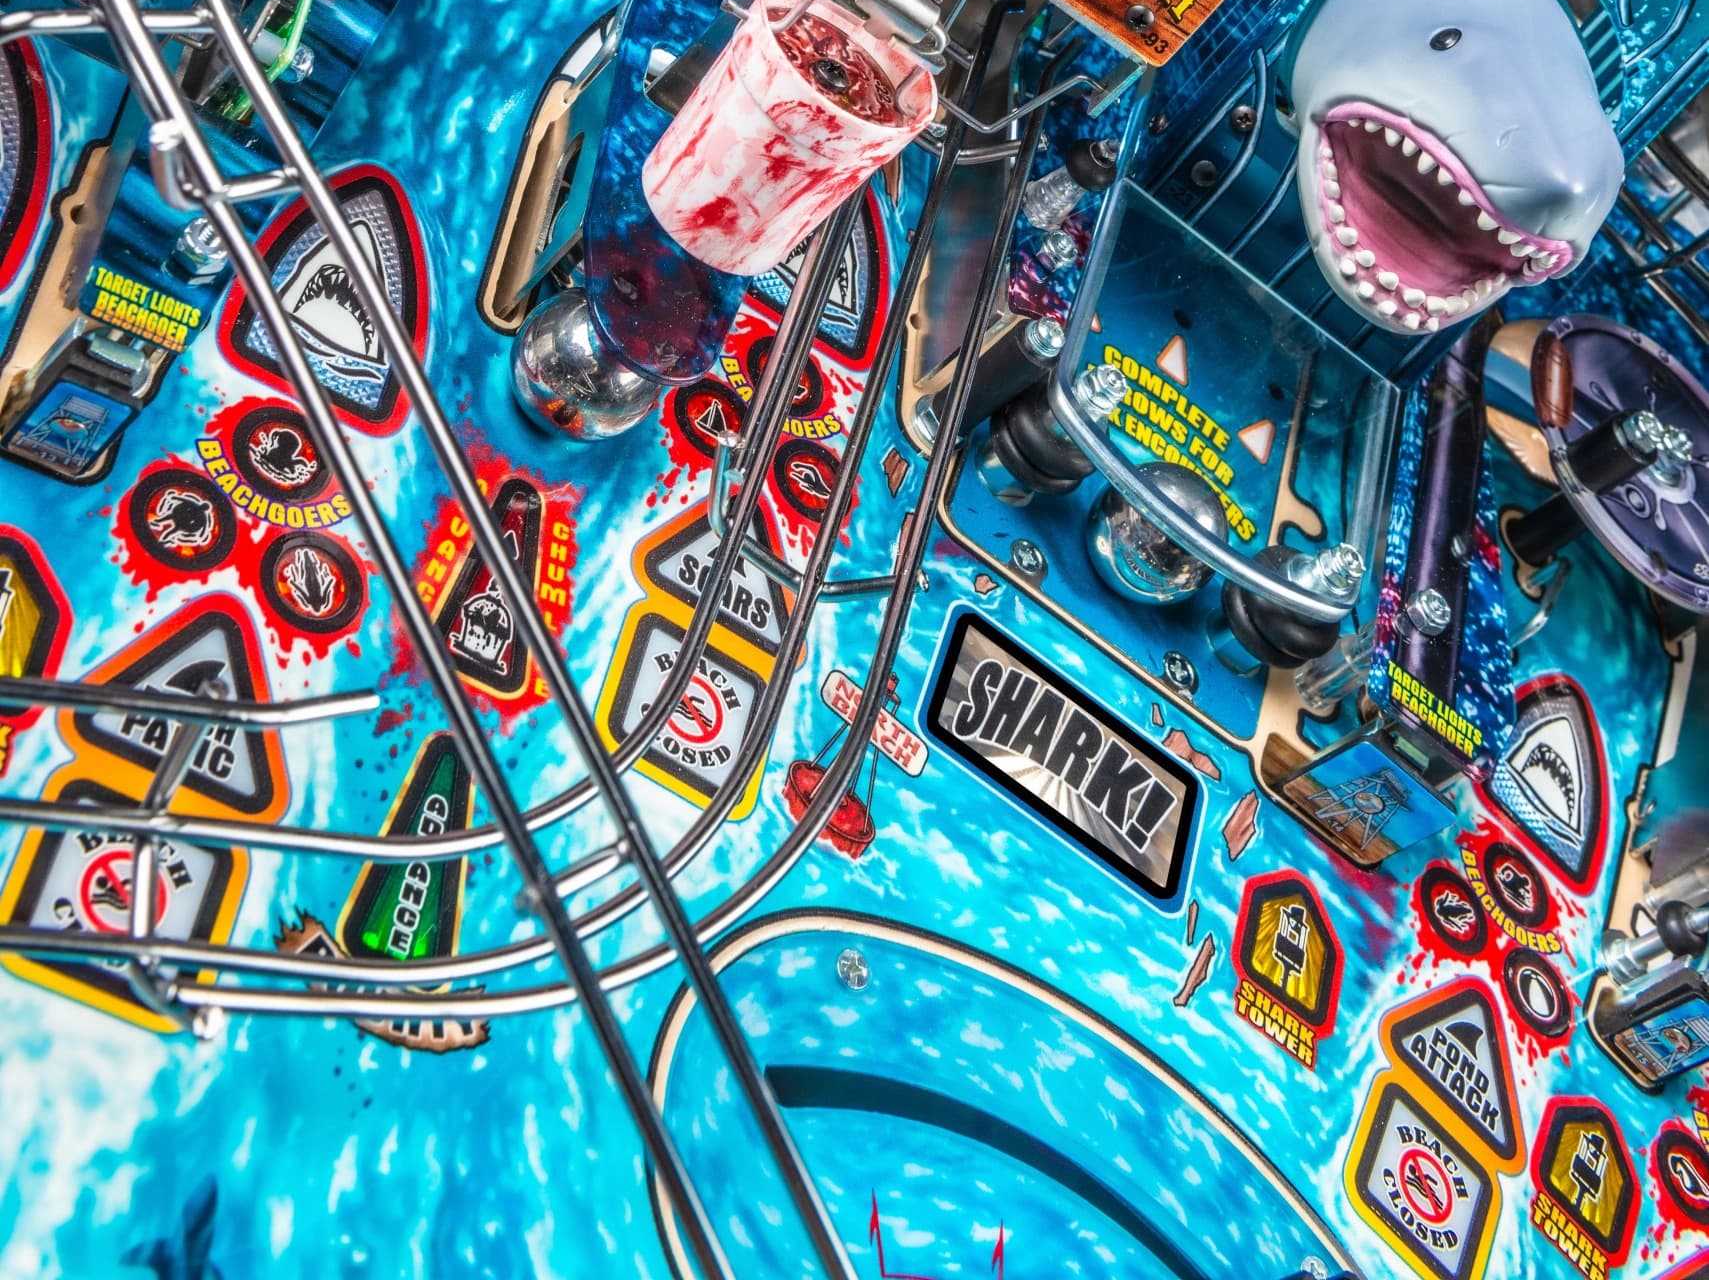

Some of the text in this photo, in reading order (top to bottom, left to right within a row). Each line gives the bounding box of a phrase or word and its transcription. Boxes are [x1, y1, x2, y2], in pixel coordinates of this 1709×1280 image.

[94, 290, 189, 346] BEACHGOER
[95, 267, 202, 328] TARGET LIGHTS
[1104, 345, 1231, 453] COMPLETE
[198, 439, 353, 529] BEACHGOERS
[1189, 436, 1235, 487] FOR
[540, 521, 571, 607] CHUM
[1388, 660, 1483, 746] TARGET LIGHTS
[1391, 681, 1474, 759] BEACHGOER
[119, 714, 236, 780] PAIC
[953, 657, 1178, 855] SHARK!
[389, 794, 448, 955] ADANCE
[1461, 848, 1562, 953] BEACHGOERS
[1237, 993, 1314, 1067] TOWER
[1241, 980, 1315, 1049] SHARK
[1410, 1034, 1500, 1132] ATTACK
[1432, 1027, 1490, 1095] POND
[1396, 1125, 1469, 1200] BEACH
[1383, 1167, 1459, 1249] CLOSED
[1537, 1192, 1608, 1274] SHARK
